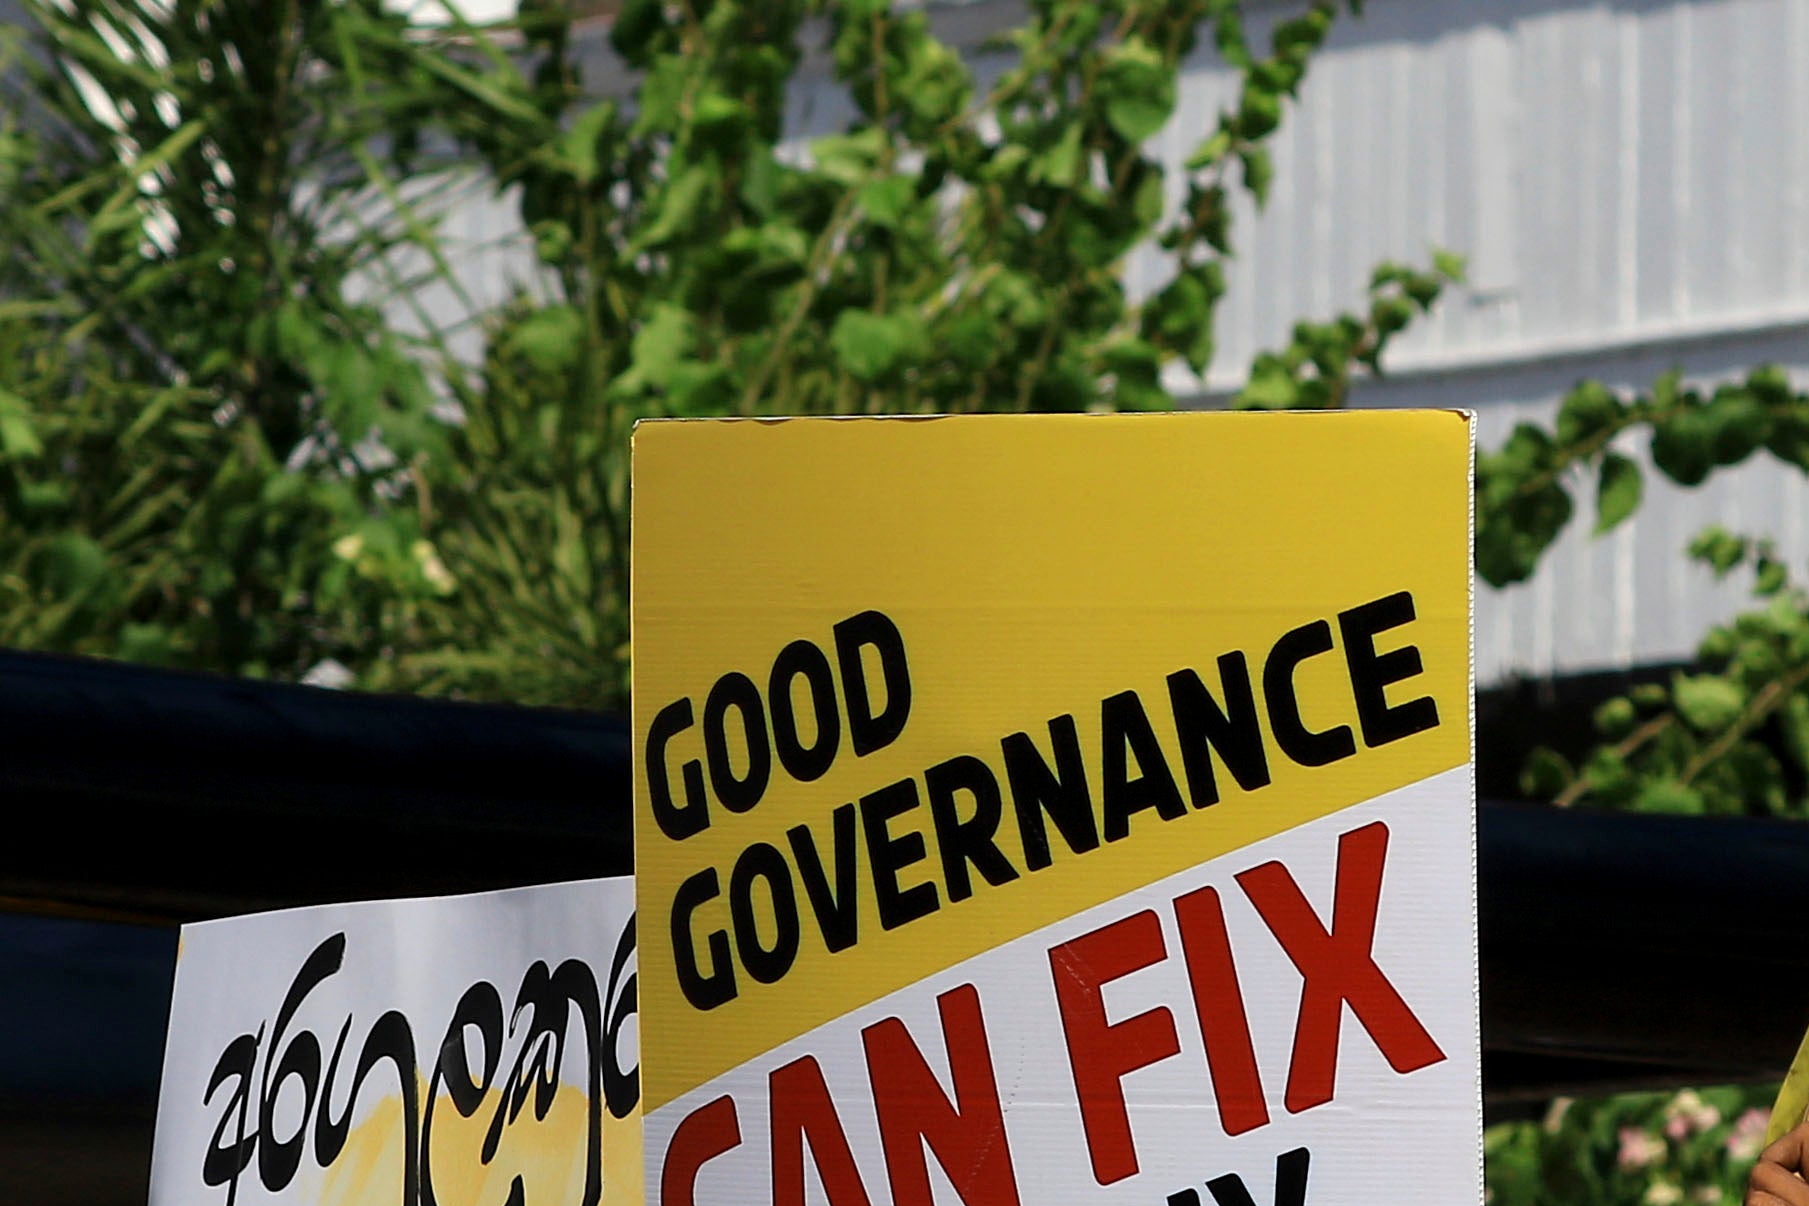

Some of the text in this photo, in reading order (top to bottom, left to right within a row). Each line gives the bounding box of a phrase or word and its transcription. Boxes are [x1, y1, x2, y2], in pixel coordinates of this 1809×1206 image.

[647, 610, 912, 842] GOOD
[670, 591, 1440, 1012] GOVERNANCE
[1047, 822, 1445, 1186] FIX
